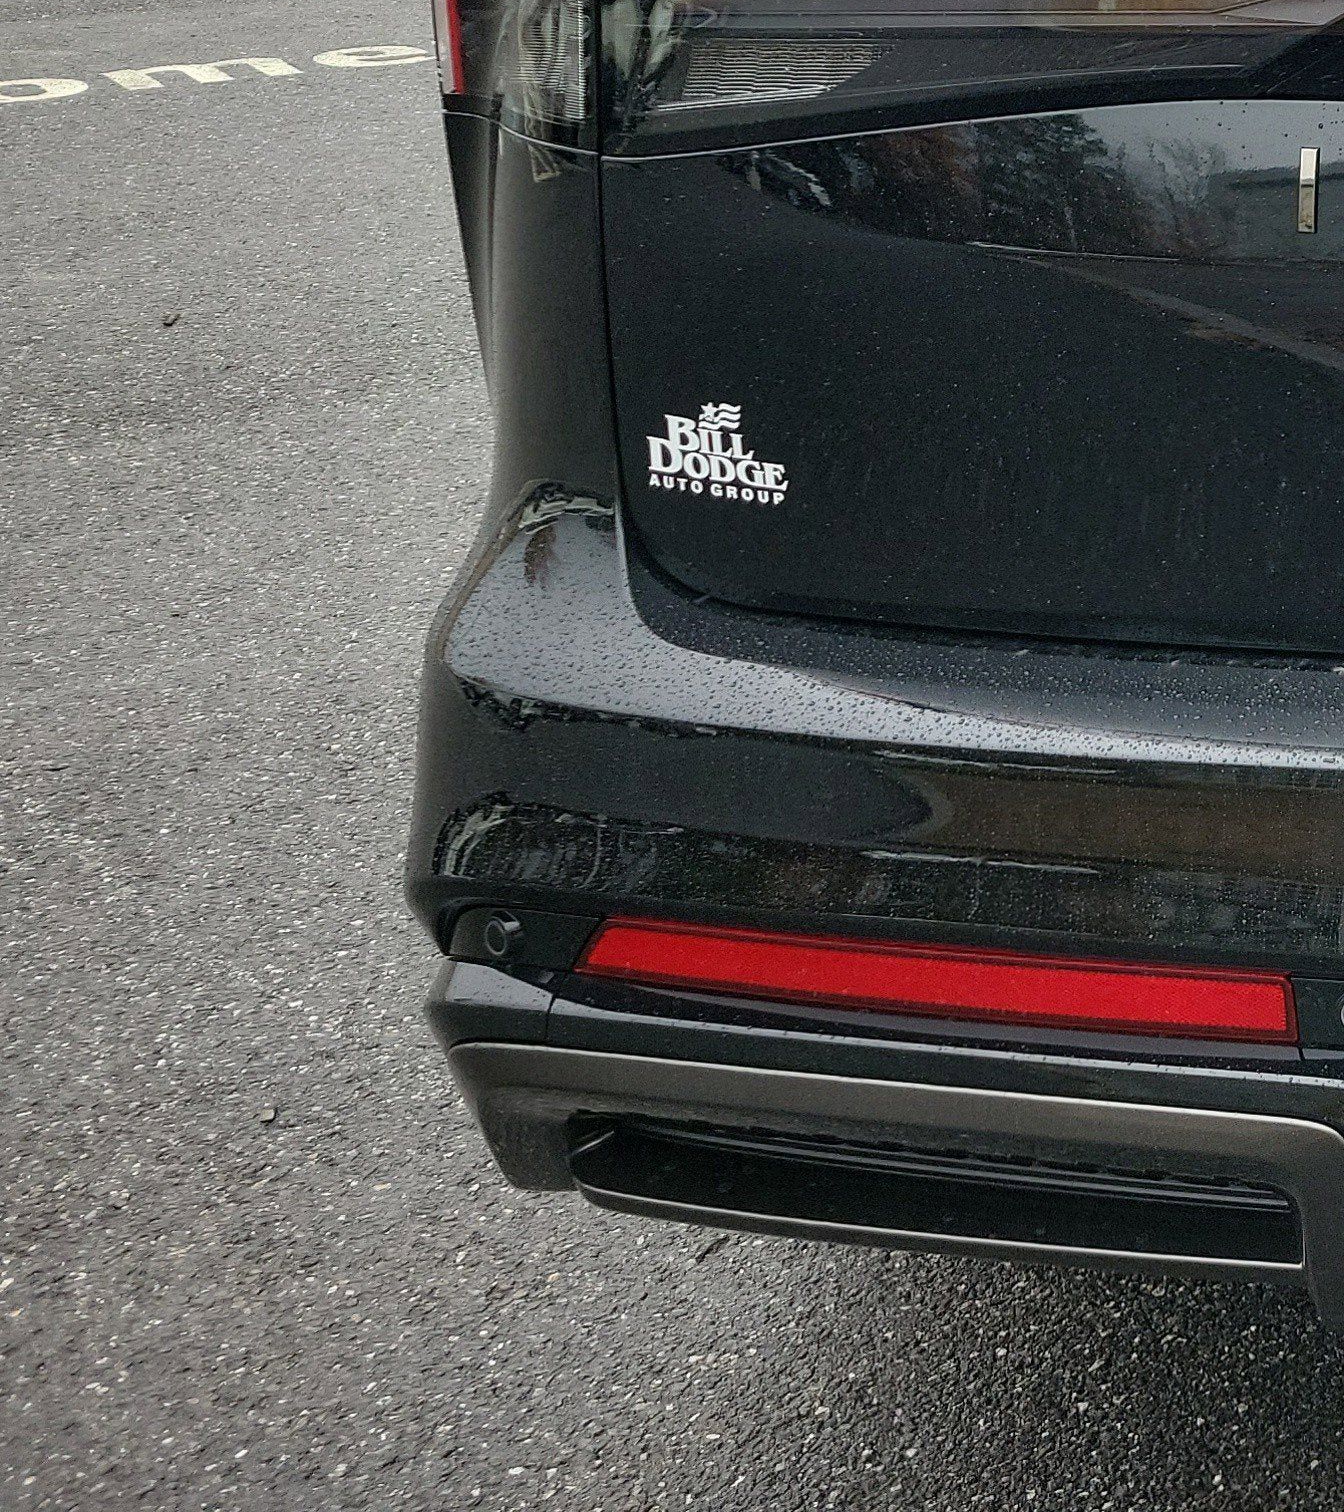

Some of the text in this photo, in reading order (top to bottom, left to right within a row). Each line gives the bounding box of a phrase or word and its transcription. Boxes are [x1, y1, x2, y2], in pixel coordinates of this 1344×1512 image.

[664, 414, 754, 461] BILL
[646, 435, 789, 492] DODGE
[649, 473, 786, 506] AUTO GROUP
